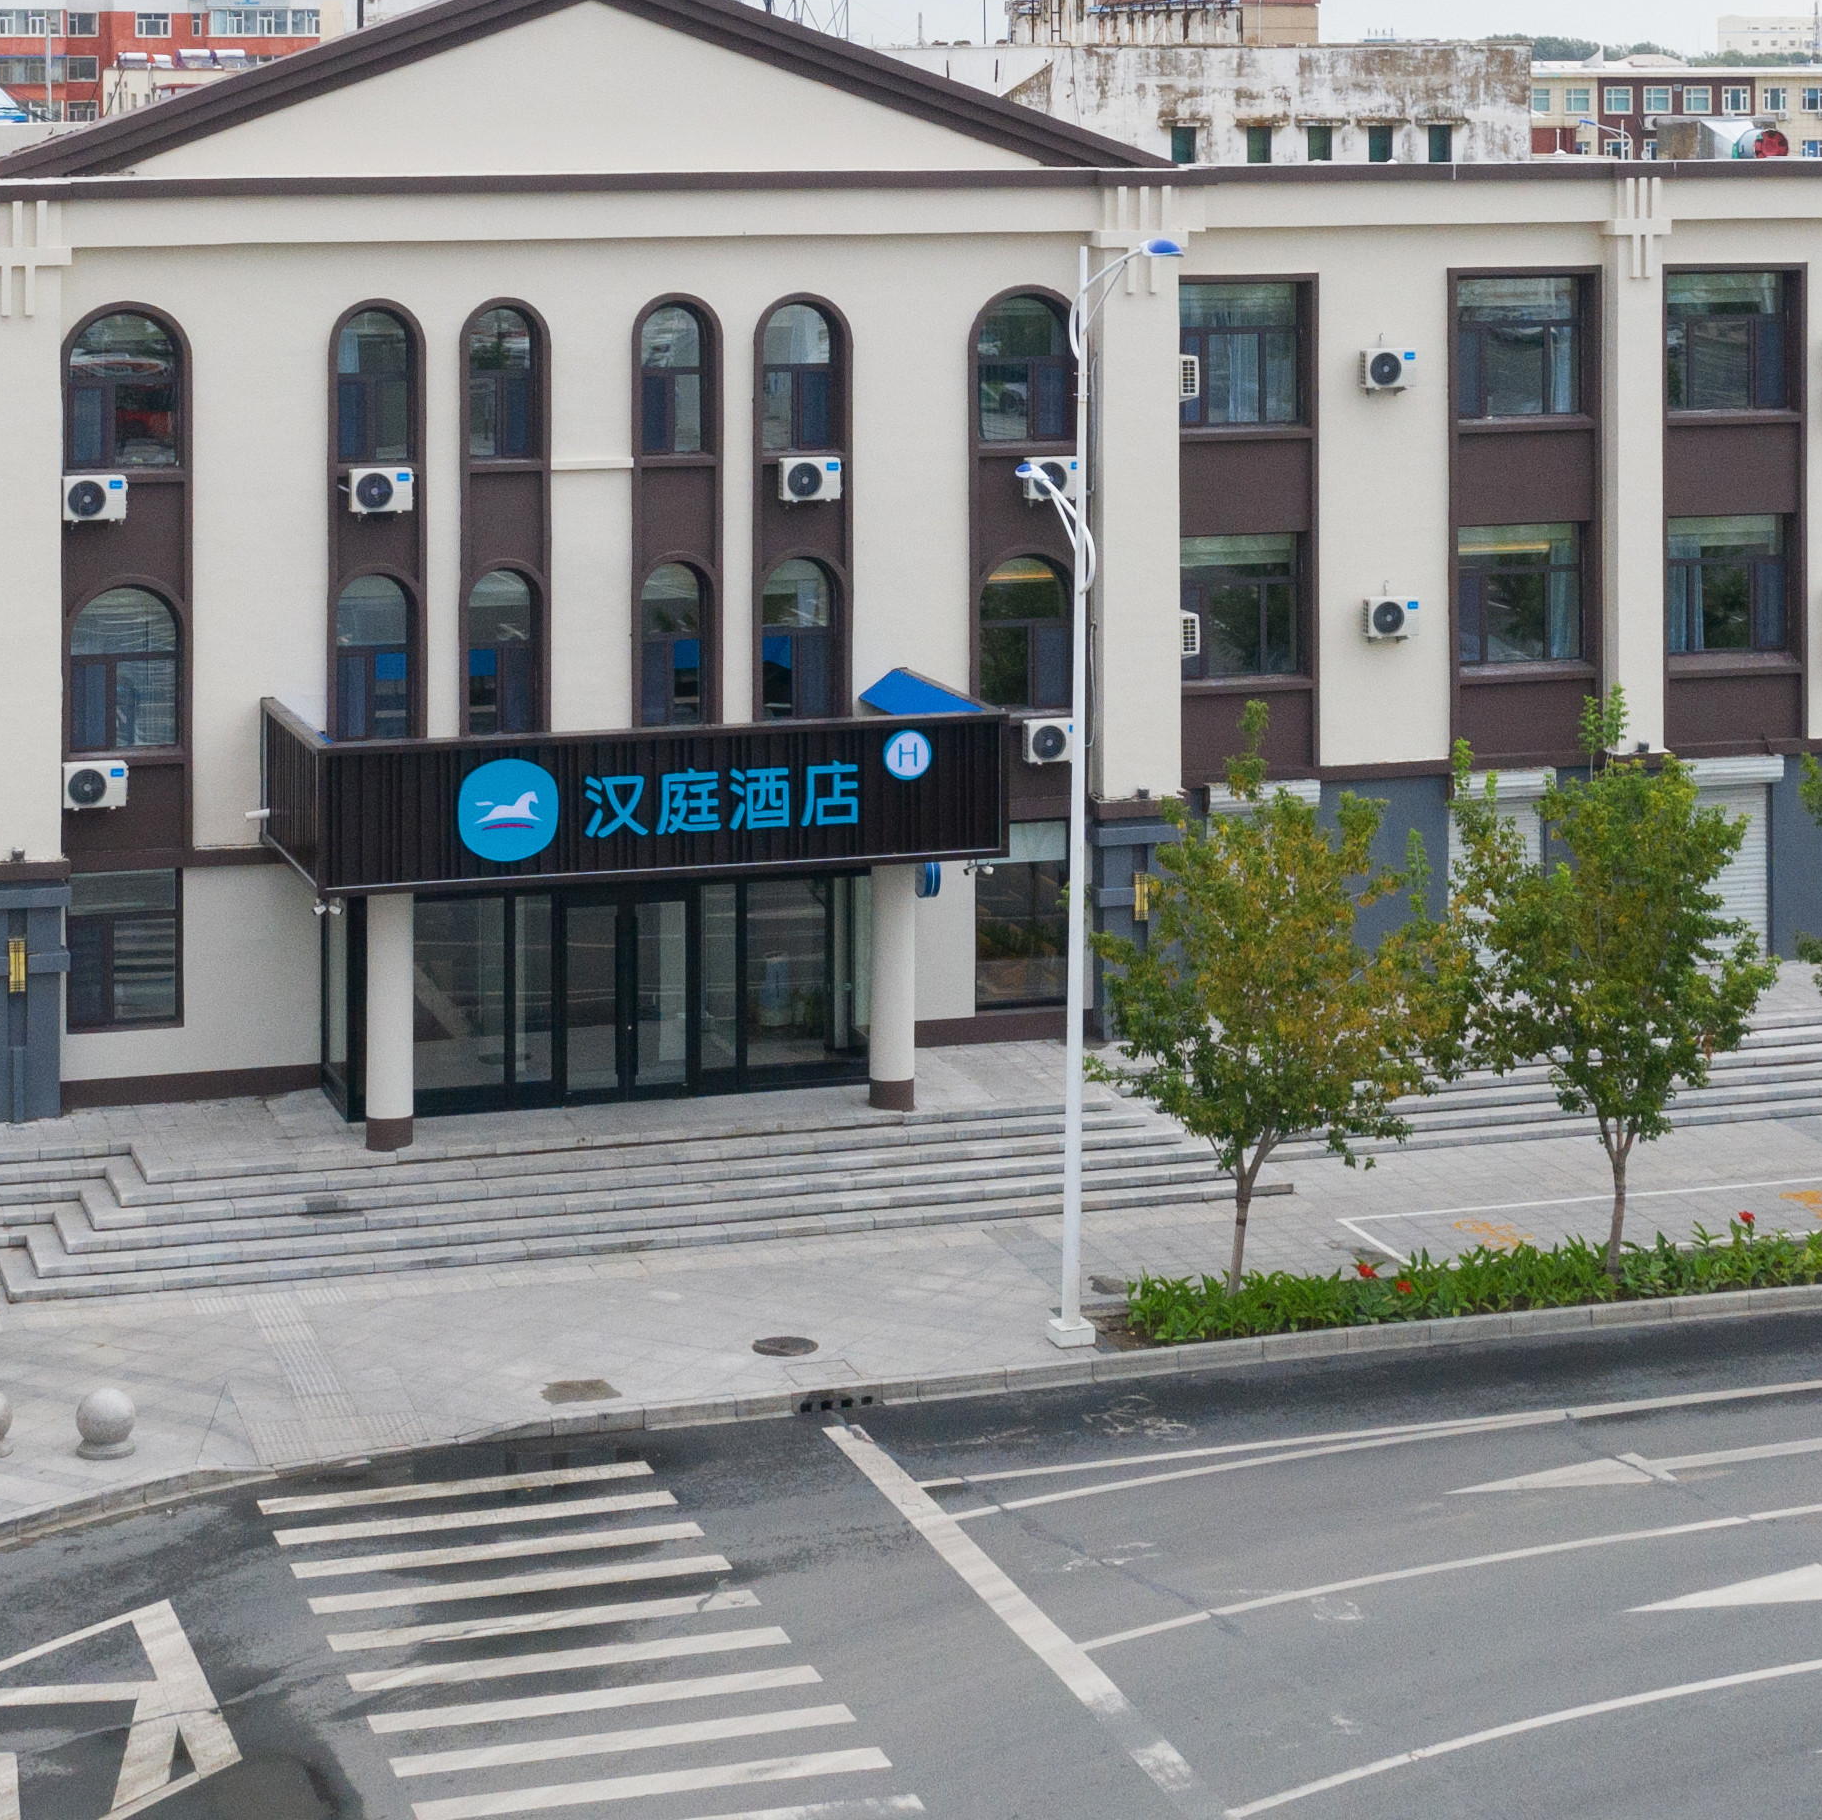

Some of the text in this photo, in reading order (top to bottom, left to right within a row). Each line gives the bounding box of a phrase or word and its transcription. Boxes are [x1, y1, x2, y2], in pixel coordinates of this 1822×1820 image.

[898, 742, 918, 768] H
[584, 760, 860, 839] 汉庭酒店
